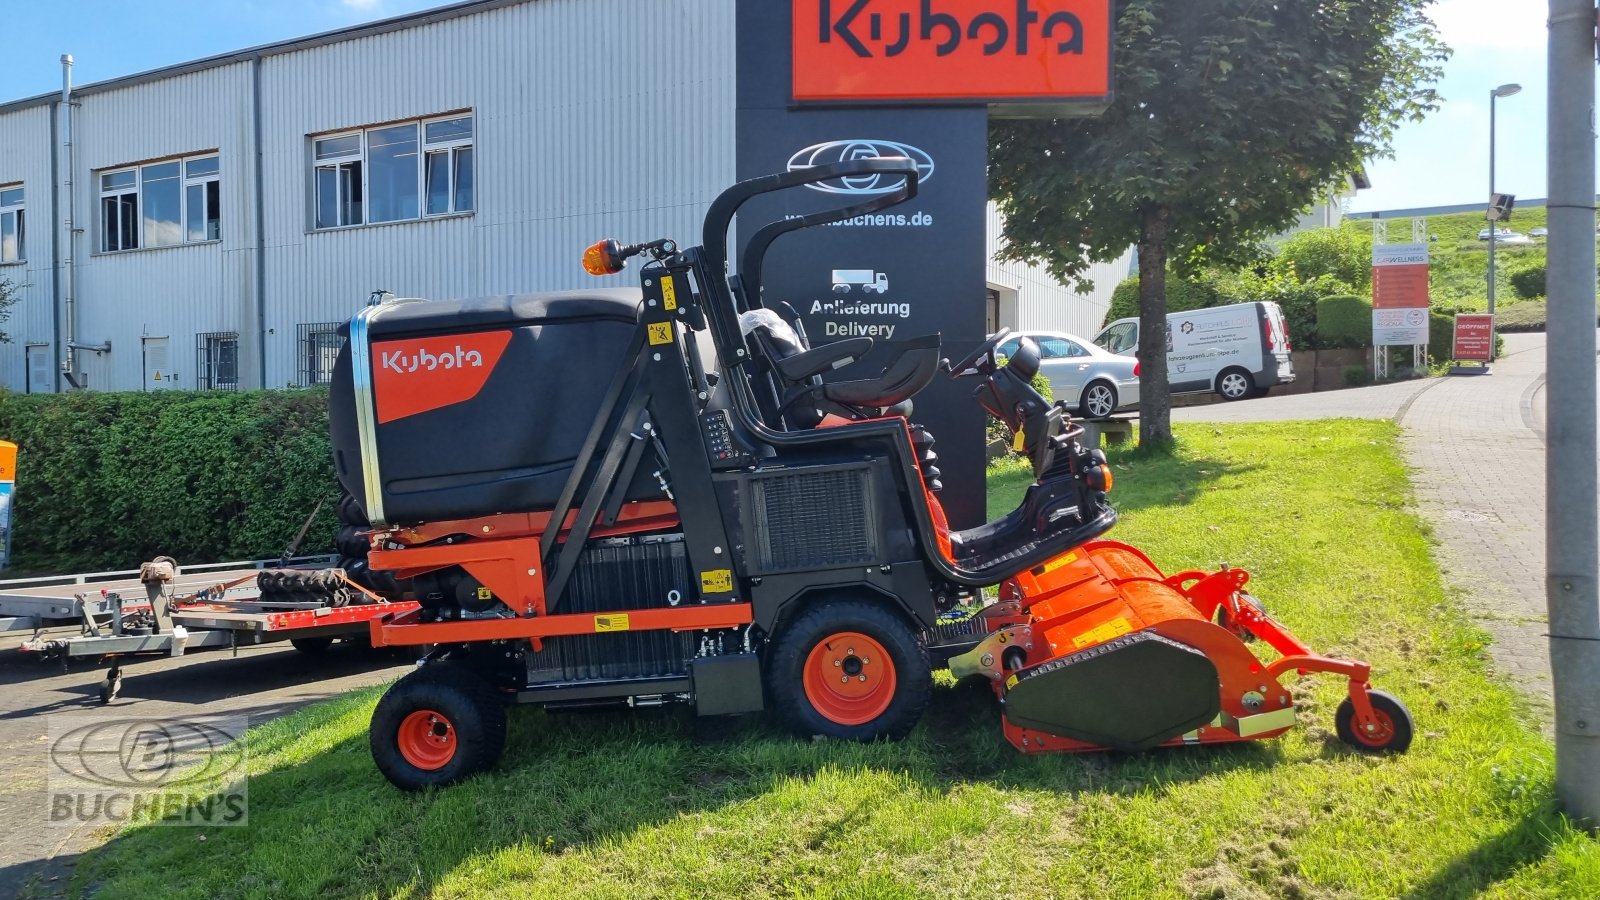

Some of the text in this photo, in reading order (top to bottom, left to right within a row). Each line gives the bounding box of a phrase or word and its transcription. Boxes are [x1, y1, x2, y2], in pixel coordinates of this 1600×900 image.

[819, 0, 1083, 58] Kubota
[810, 300, 910, 318] Anlieferung
[825, 321, 896, 340] Delivery
[382, 345, 482, 374] Kubota
